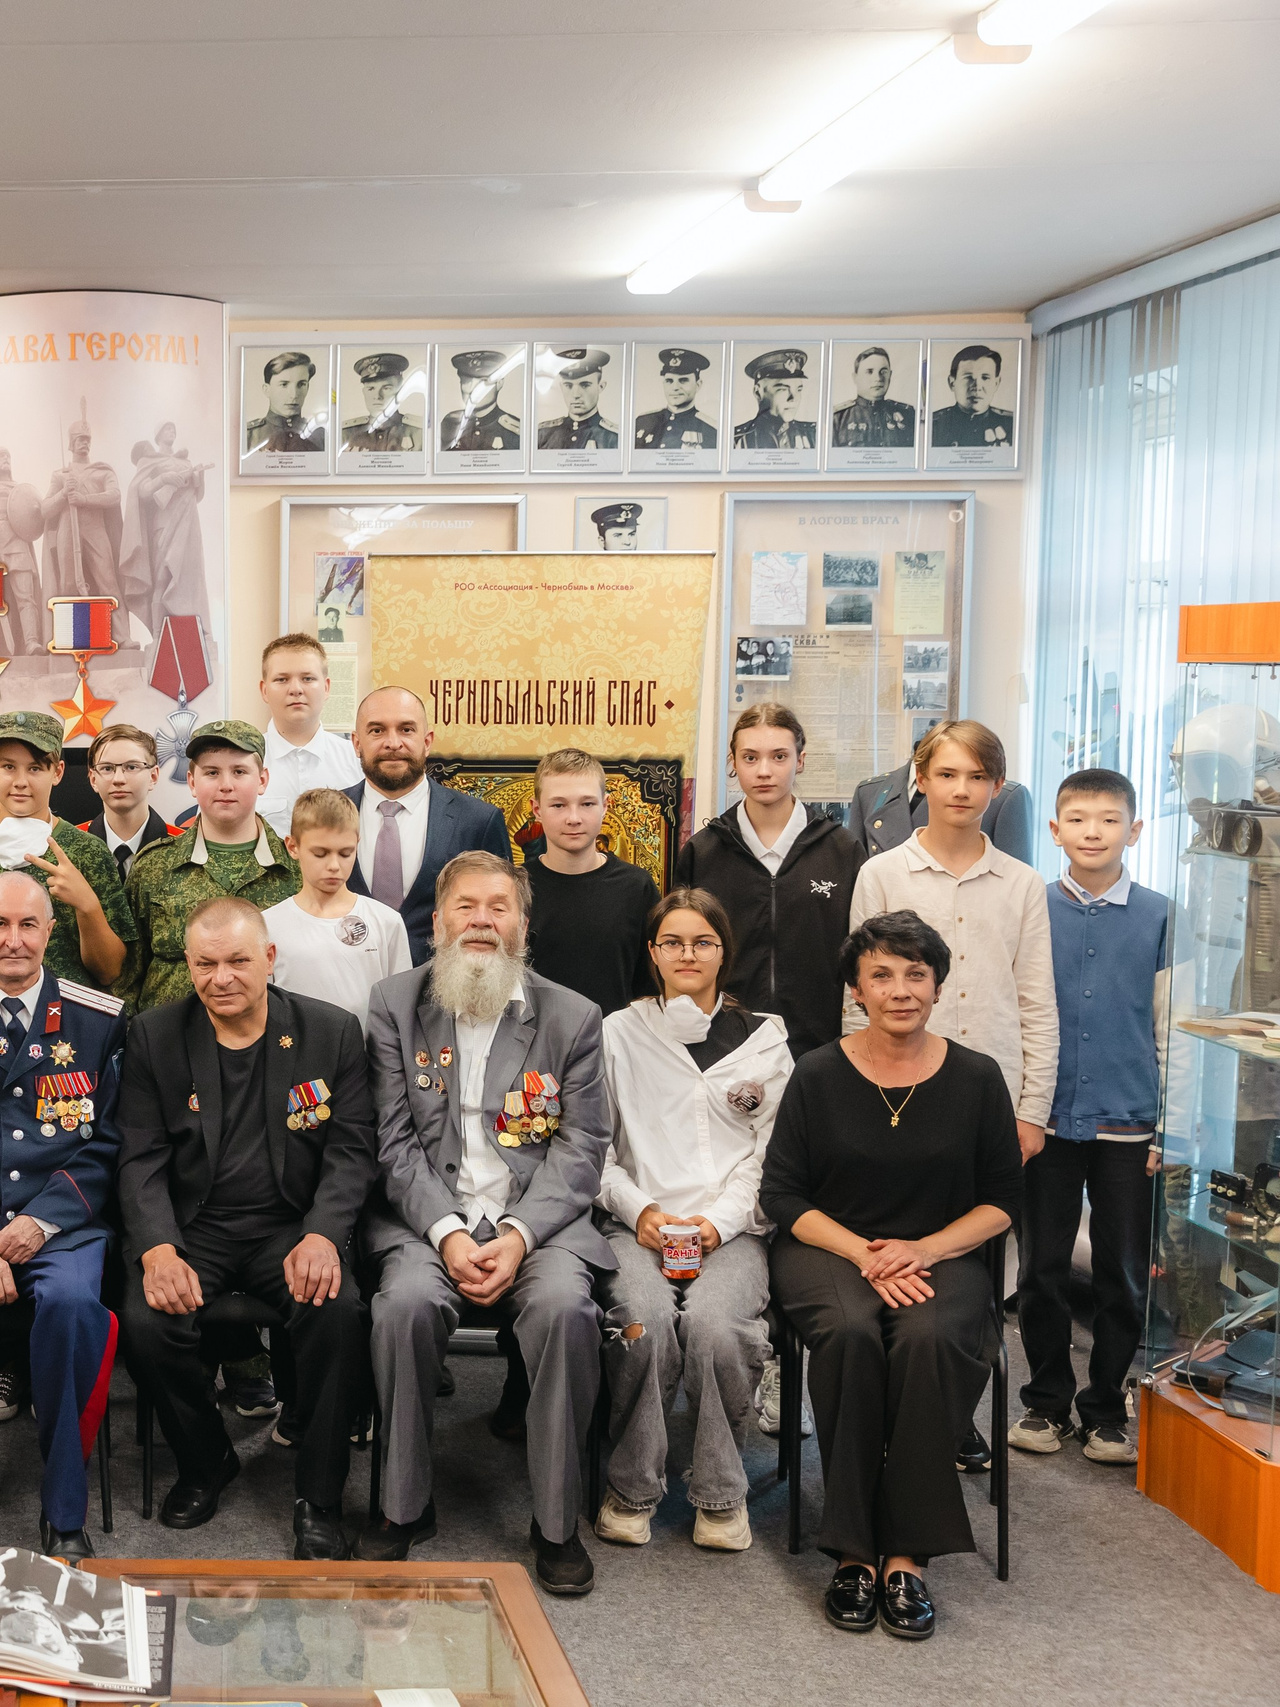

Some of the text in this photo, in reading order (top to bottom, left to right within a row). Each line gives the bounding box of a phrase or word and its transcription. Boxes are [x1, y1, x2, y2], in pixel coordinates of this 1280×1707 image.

[404, 520, 419, 529] ЗА
[422, 519, 474, 529] ПОЛЬШУ
[798, 516, 900, 526] В ЛОГОВЕ ВРАГА
[454, 582, 476, 591] РОО
[477, 582, 533, 592] «Ассоциация
[540, 582, 588, 592] Чернобыль
[597, 582, 635, 591] Москве»
[429, 676, 658, 728] ЧЕРНОБЫЛЬСКИЙ СПАС
